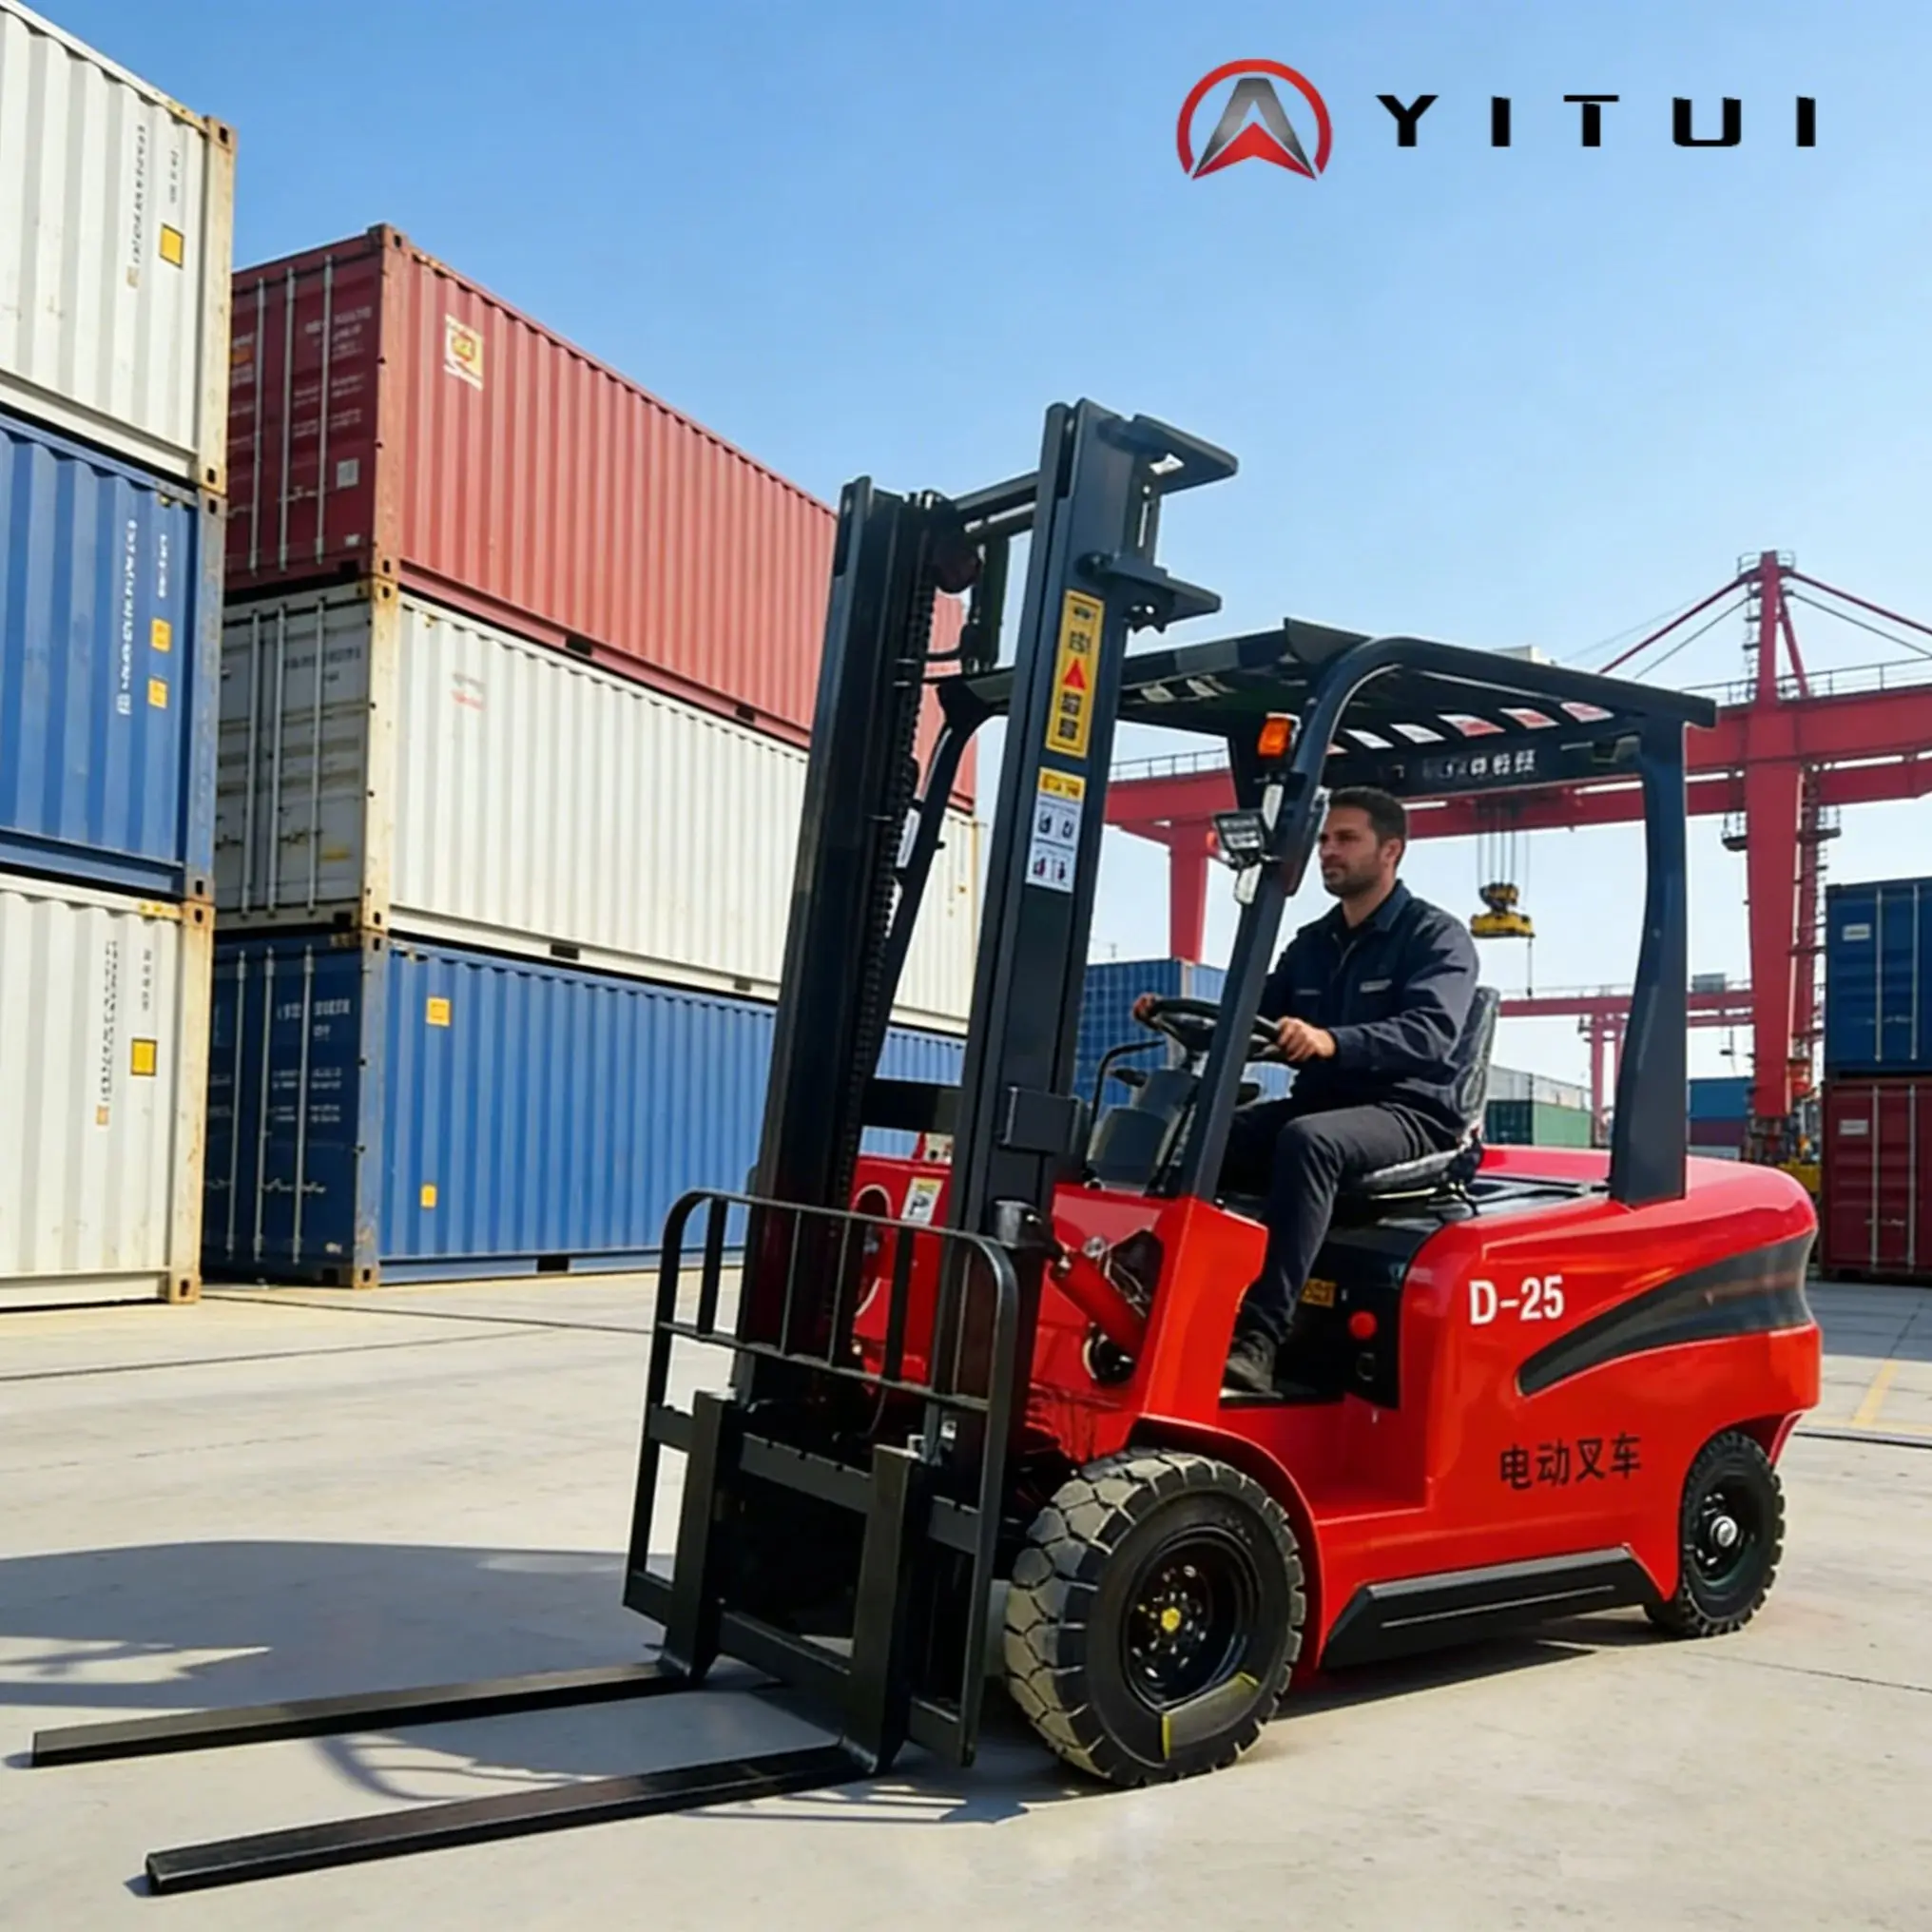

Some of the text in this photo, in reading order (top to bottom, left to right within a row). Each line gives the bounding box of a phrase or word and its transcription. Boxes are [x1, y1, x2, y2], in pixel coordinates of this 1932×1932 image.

[1469, 1274, 1564, 1324] D-25
[1500, 1433, 1641, 1490] 电动叉车
